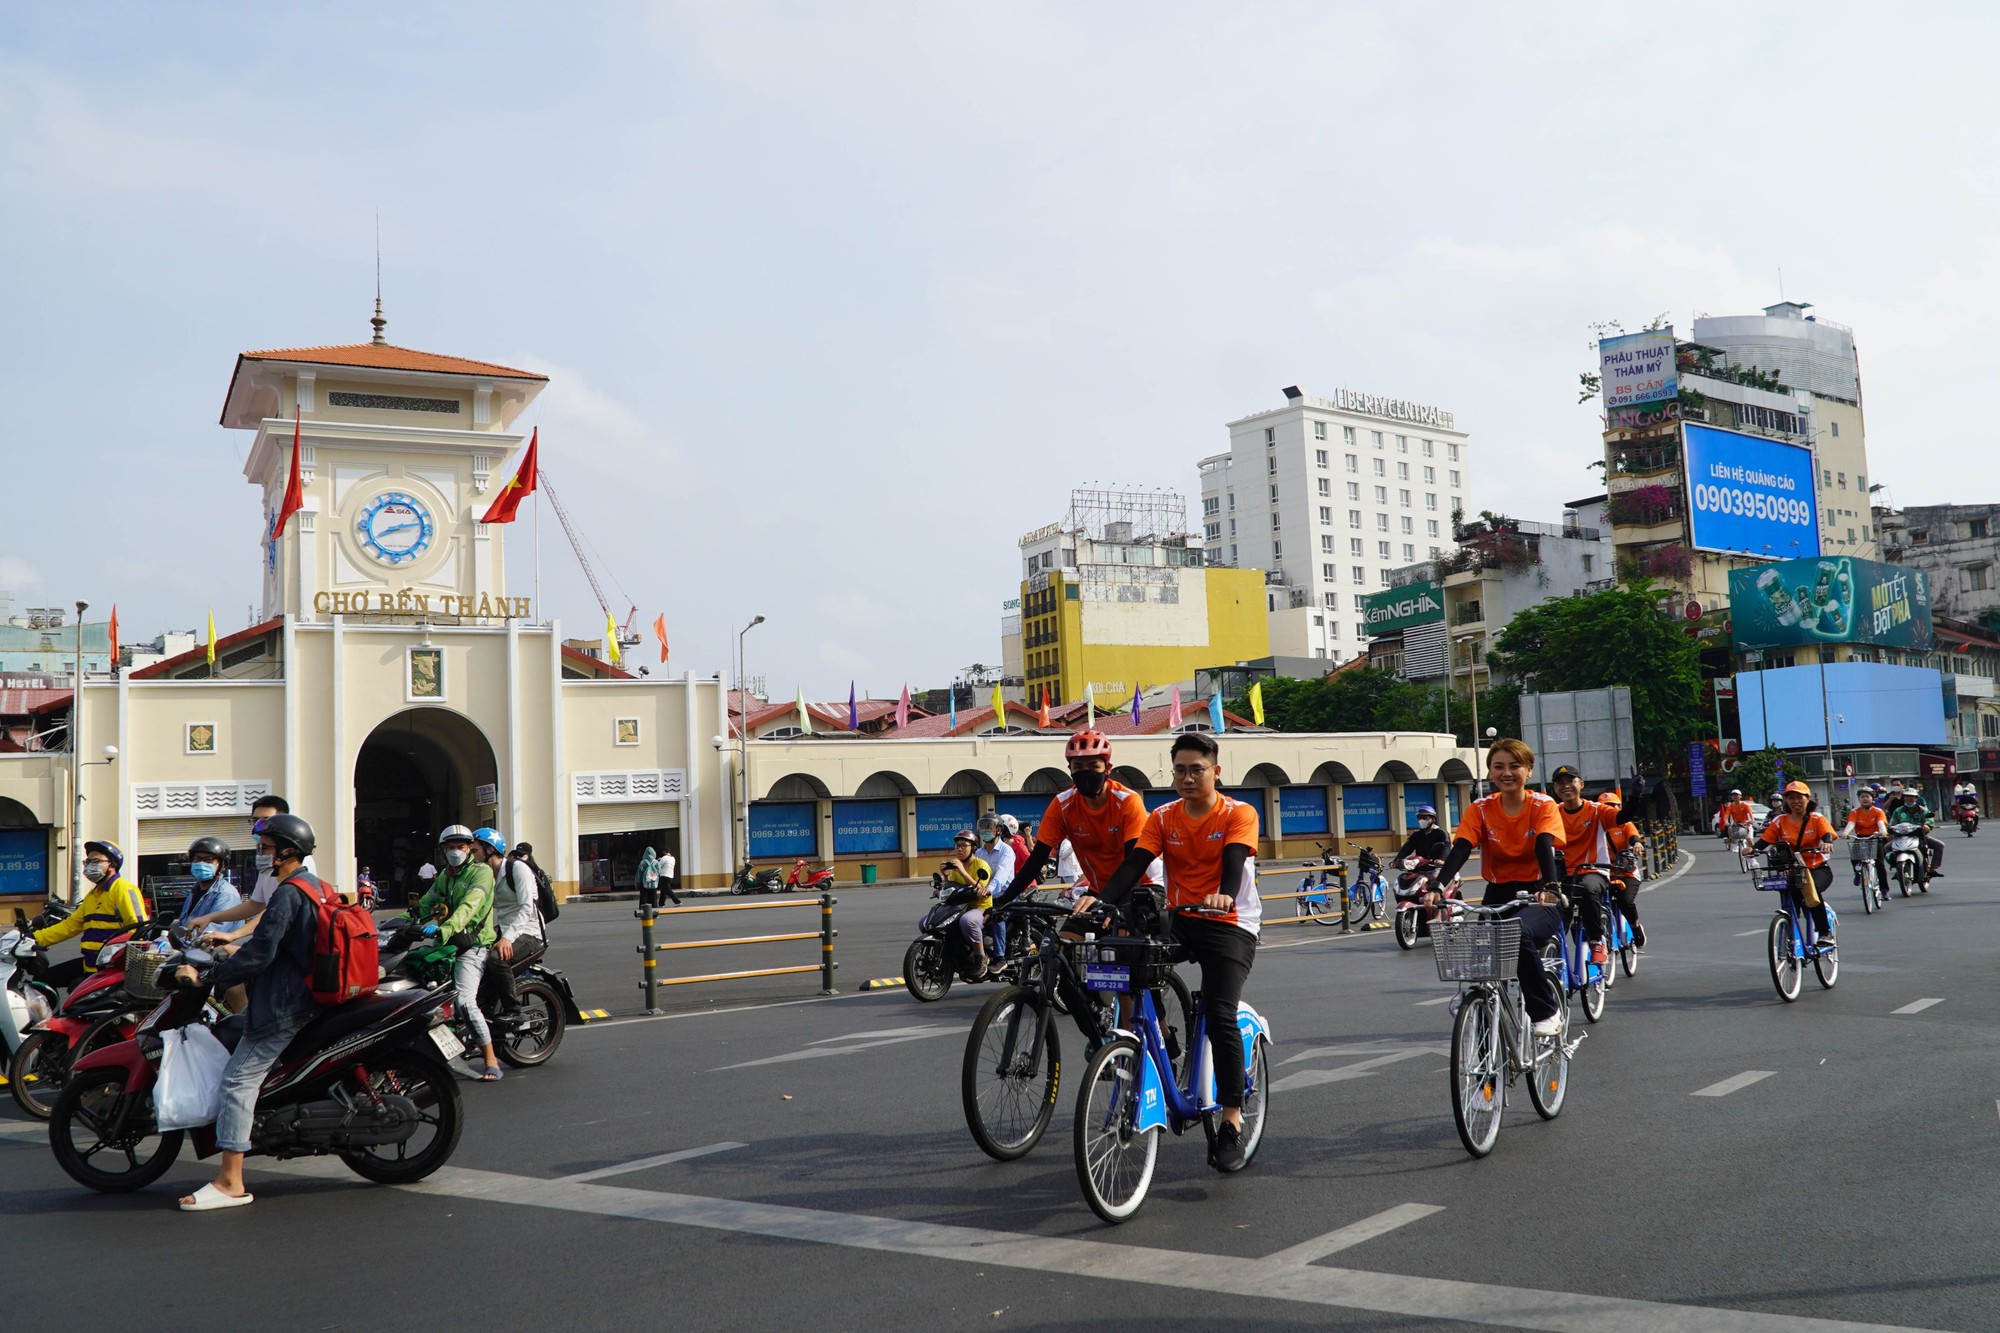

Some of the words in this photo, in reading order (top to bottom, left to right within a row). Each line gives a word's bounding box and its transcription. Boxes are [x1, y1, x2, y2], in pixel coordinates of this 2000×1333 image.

[1635, 345, 1670, 360] THUẬT
[1615, 385, 1632, 395] BS
[1618, 395, 1633, 403] 091
[1635, 393, 1651, 401] 666
[1652, 389, 1673, 399] 0593
[1334, 387, 1386, 415] LIBERTY
[1387, 398, 1443, 426] CENTRAL
[1710, 461, 1731, 479] LIÊN
[1731, 465, 1745, 484] HỆ
[1745, 469, 1777, 488] QUẢNG
[1777, 474, 1795, 491] CÁO
[1695, 483, 1810, 527] 0903950999
[313, 589, 370, 616] CHỢ
[378, 586, 430, 616] BẾN
[439, 590, 532, 618] THÀNH
[751, 828, 811, 839] 0969.39.89.89
[837, 825, 894, 835] 0969.39.89.89
[920, 823, 973, 832] 0969.39.89.89
